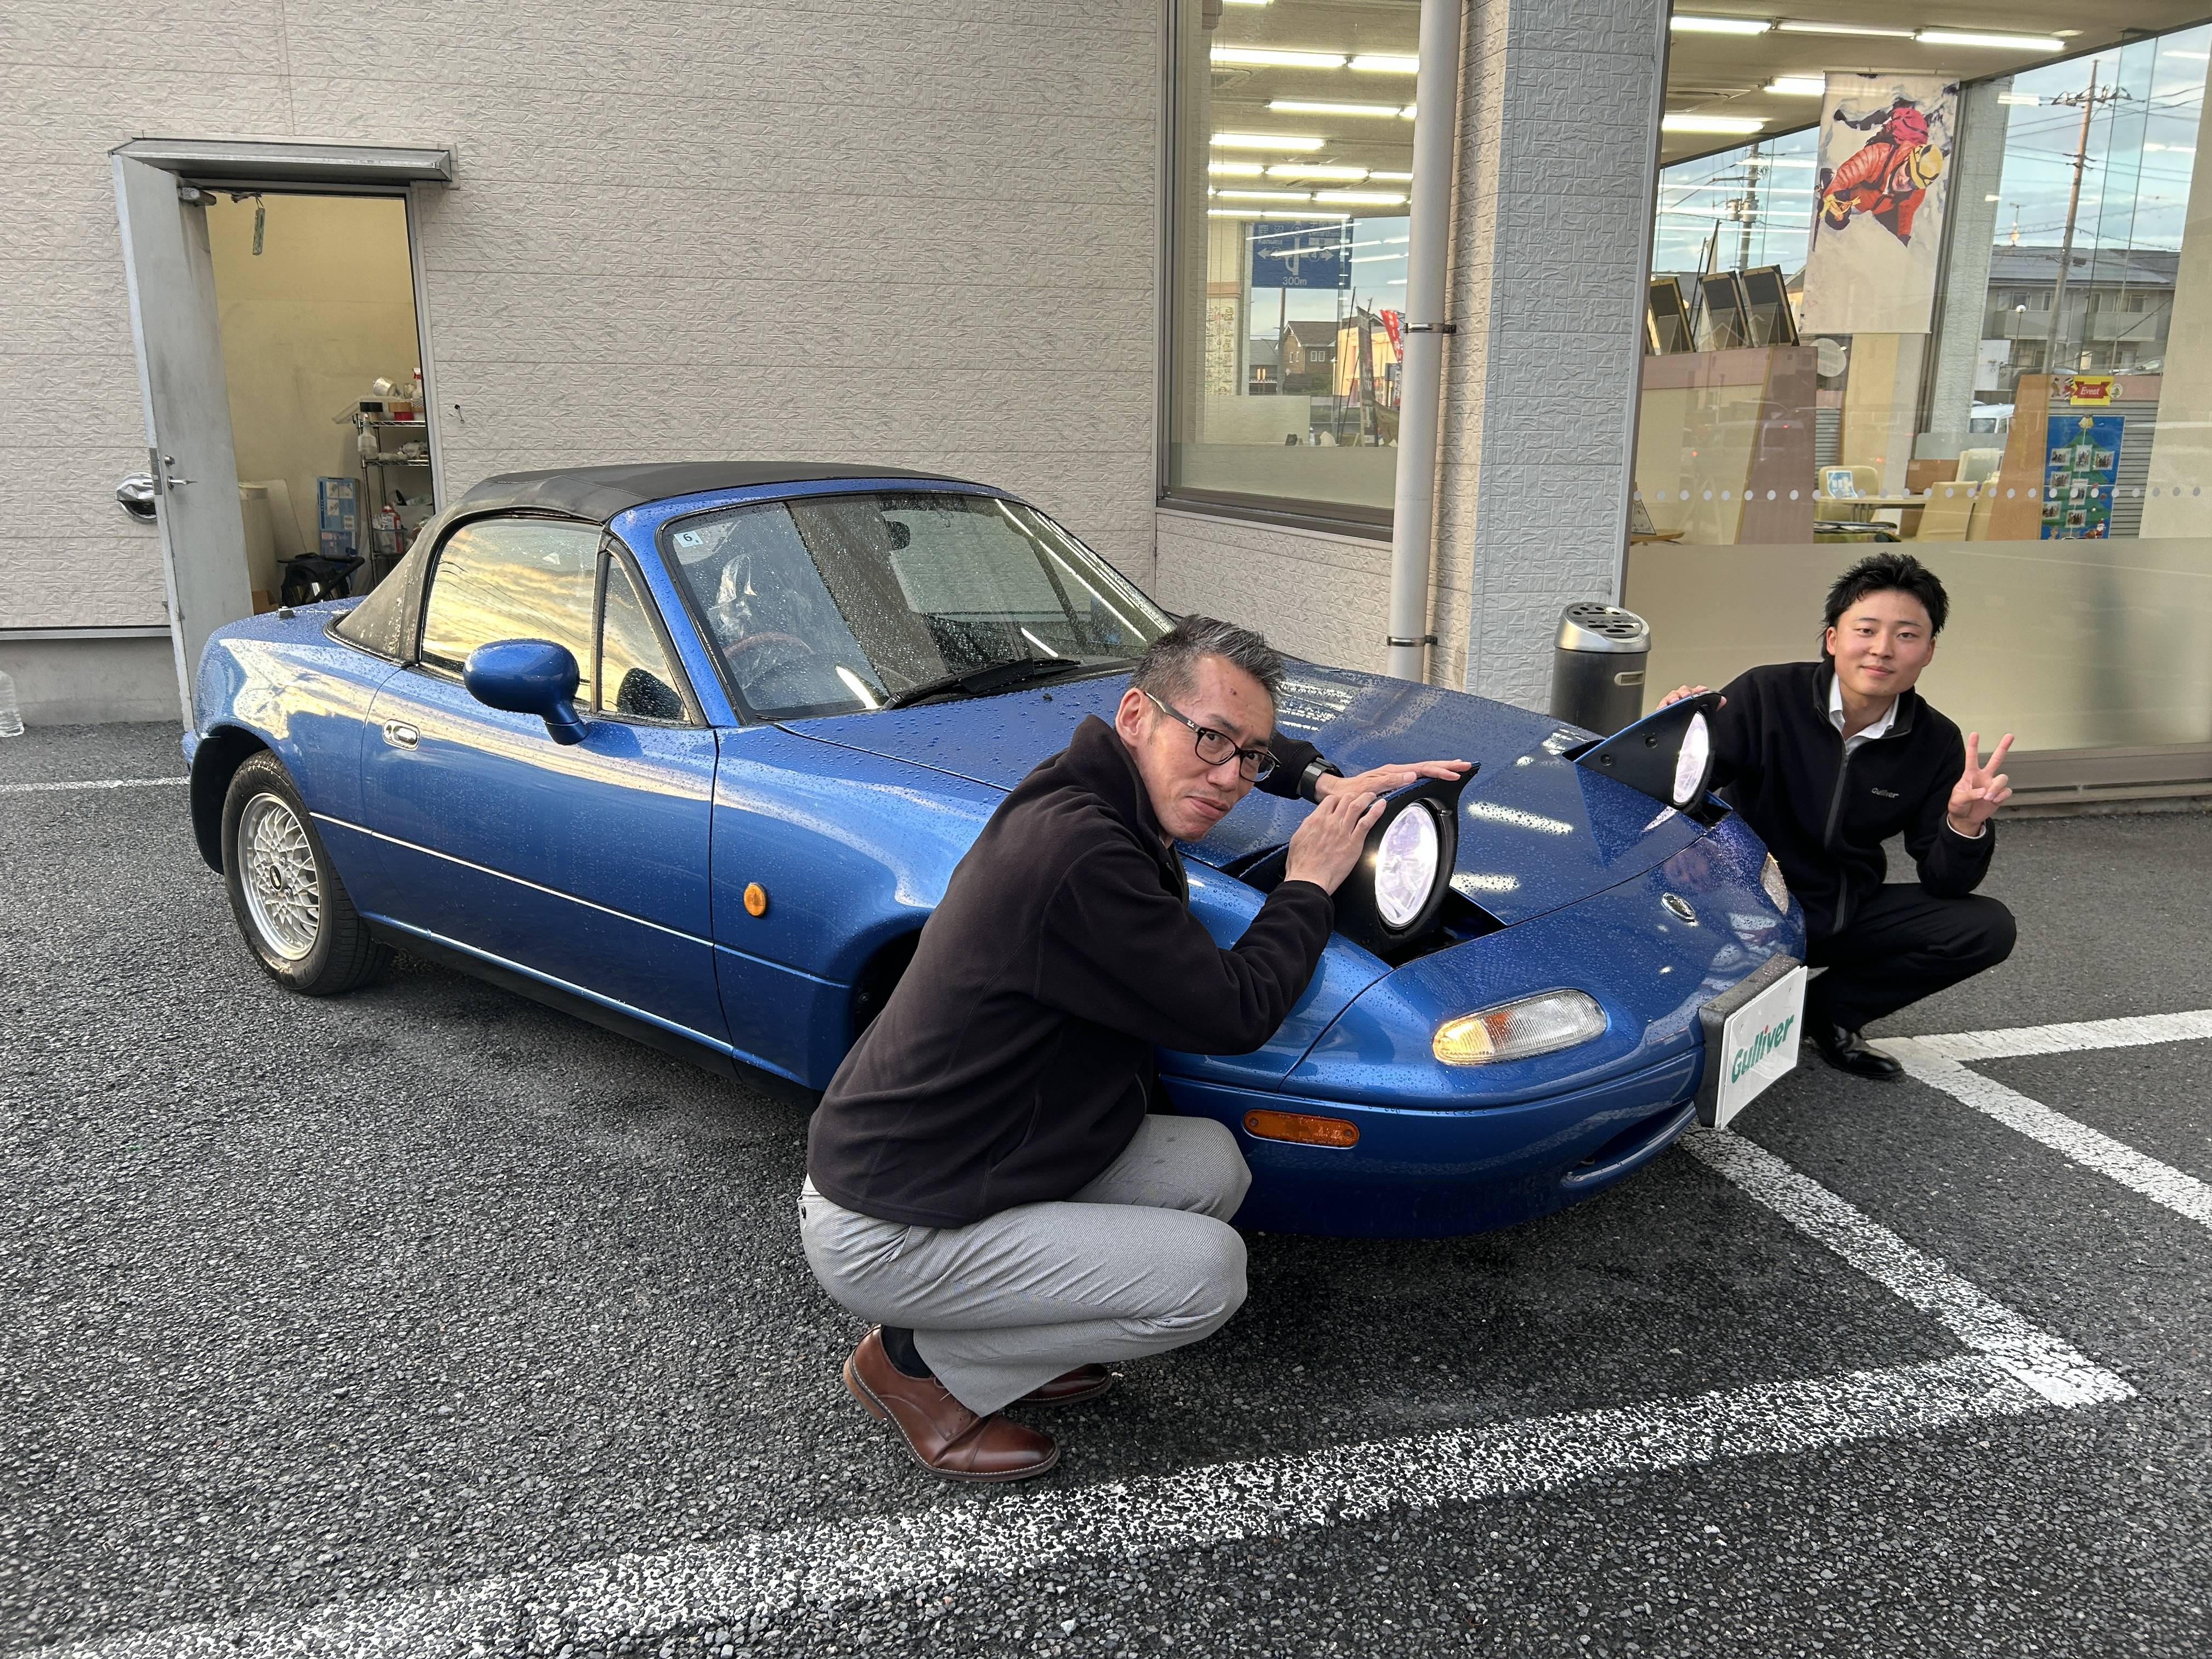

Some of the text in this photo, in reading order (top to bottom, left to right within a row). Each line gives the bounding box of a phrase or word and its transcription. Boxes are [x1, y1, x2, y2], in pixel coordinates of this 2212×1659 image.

[1283, 276, 1307, 285] 300m
[2080, 386, 2100, 395] Event
[683, 533, 692, 541] 6
[1871, 787, 1899, 798] Gulliver
[1731, 1014, 1795, 1084] Gulliver
